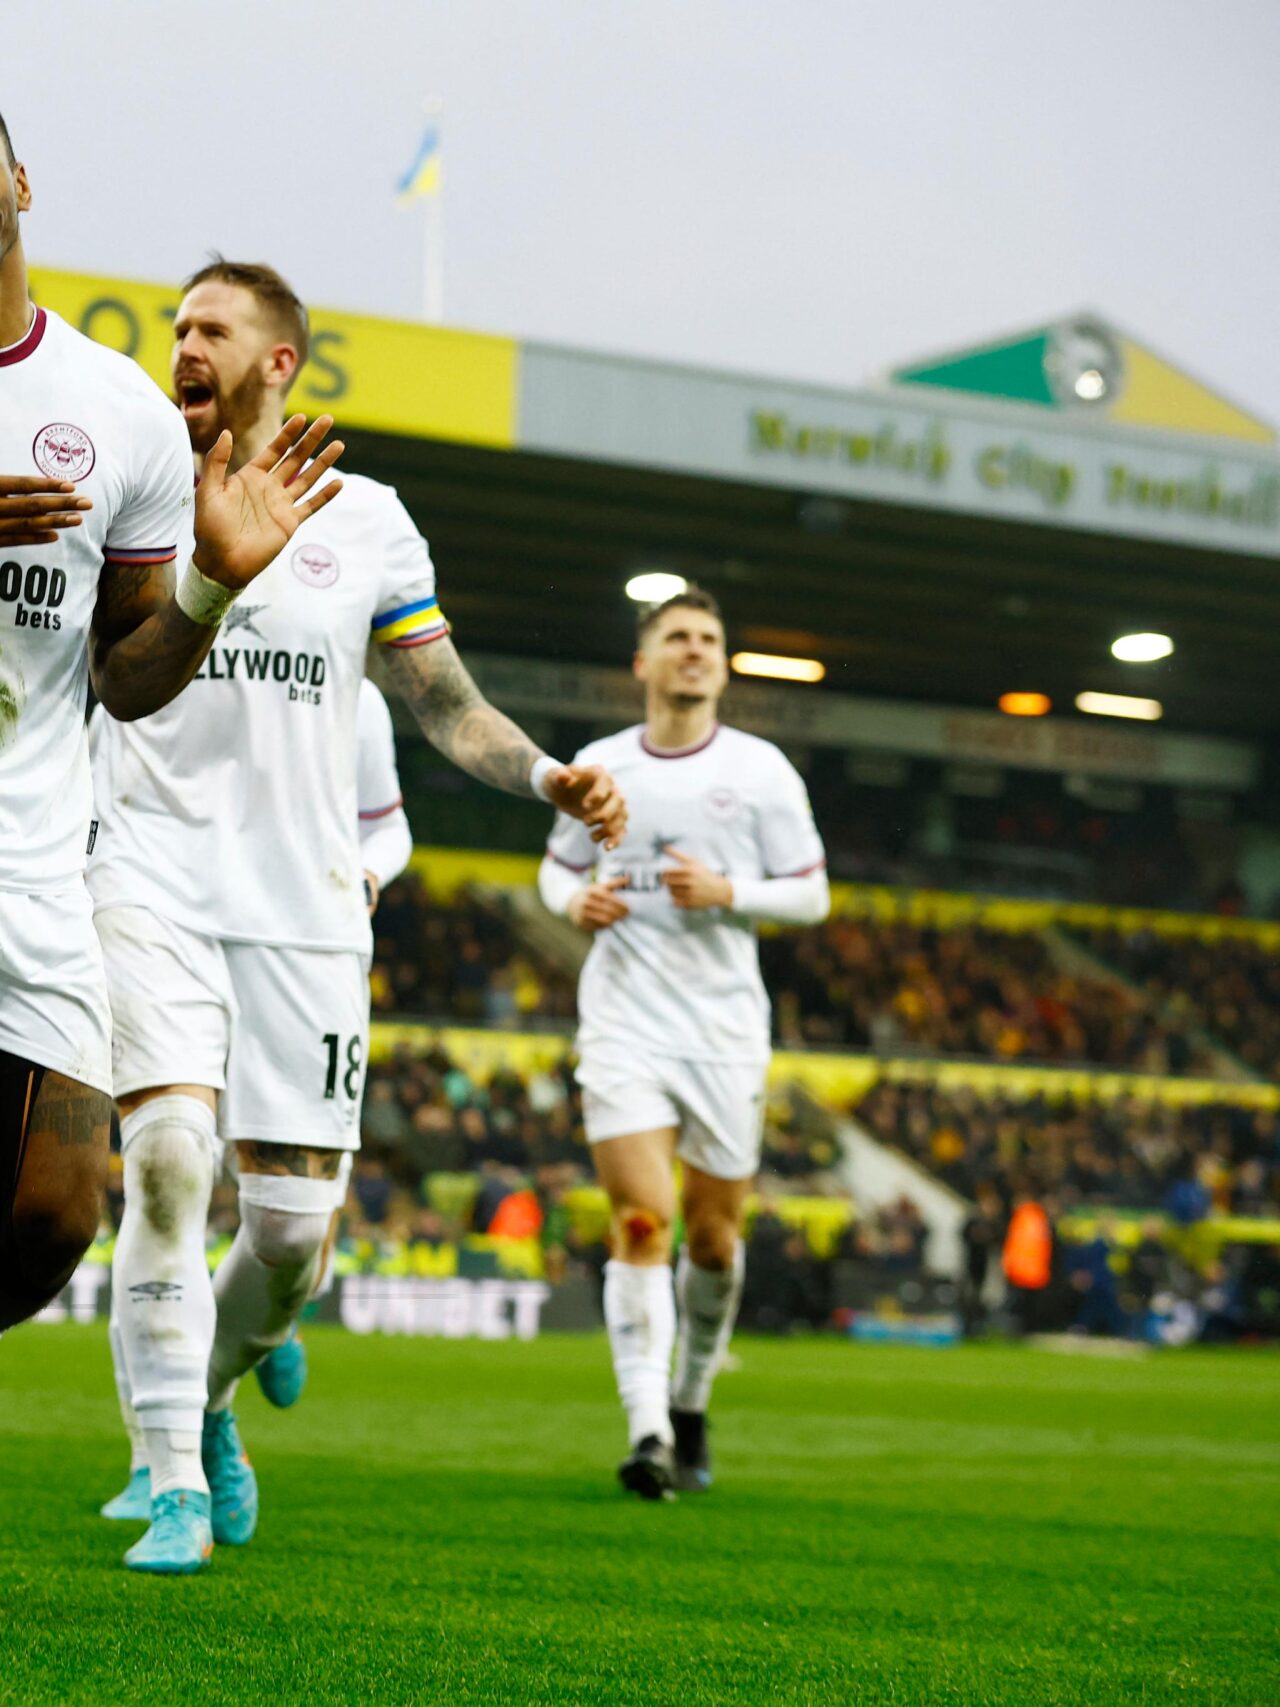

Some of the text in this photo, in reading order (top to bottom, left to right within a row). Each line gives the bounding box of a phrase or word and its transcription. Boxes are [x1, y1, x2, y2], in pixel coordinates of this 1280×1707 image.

[15, 603, 61, 631] bets
[194, 648, 325, 687] LYWOOD
[322, 1033, 360, 1101] 18
